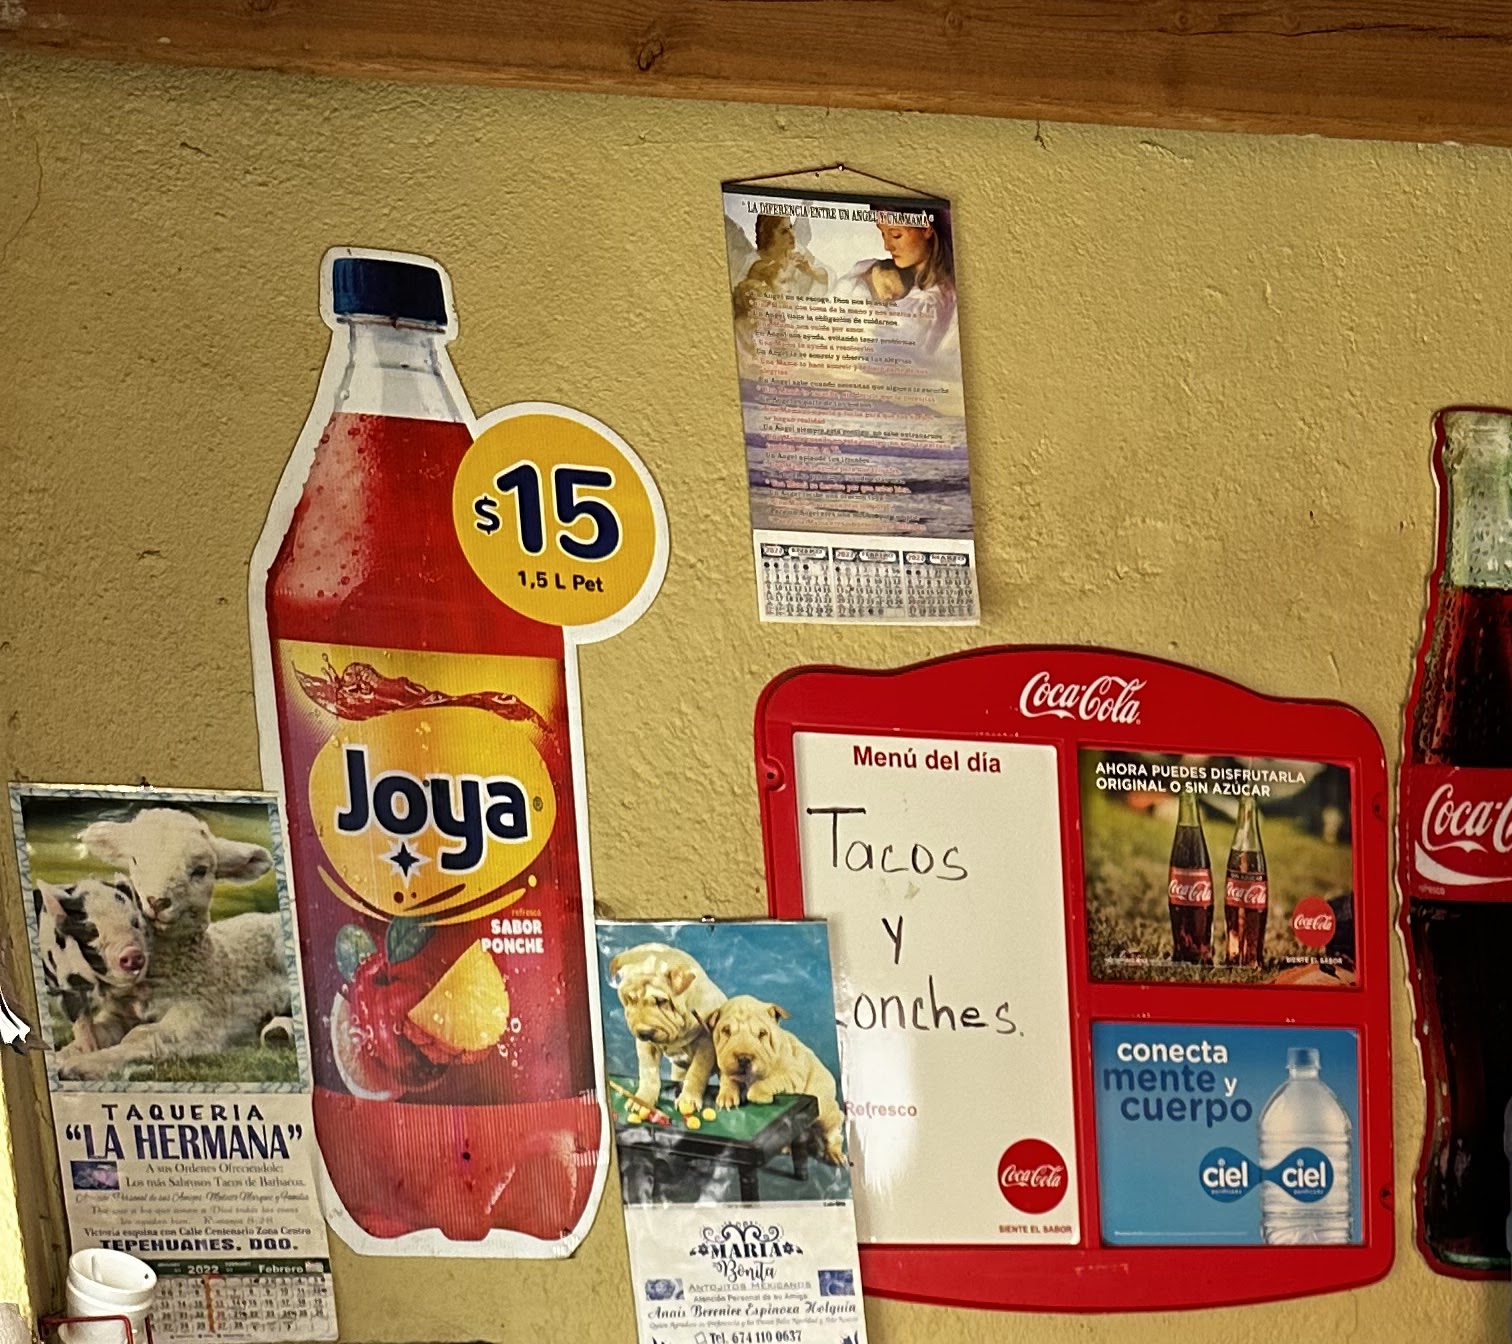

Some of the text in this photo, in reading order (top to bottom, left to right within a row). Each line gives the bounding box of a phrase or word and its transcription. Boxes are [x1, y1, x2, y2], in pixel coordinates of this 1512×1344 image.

[760, 202, 808, 217] DIFERENCIA
[810, 206, 836, 219] ENTRE
[839, 208, 849, 220] UN
[474, 464, 619, 559] $15
[518, 571, 603, 592] 1,5 L Pet
[1019, 671, 1147, 724] Coca-Cola
[853, 745, 1001, 773] Menú del día
[1096, 762, 1305, 784] AHORA PUEDES DISFRUTARLA
[1096, 777, 1270, 797] ORIGINAL O SIN AZÚCAR
[338, 749, 529, 871] Joya
[807, 807, 968, 880] Tacos
[491, 920, 542, 935] SABOR
[1294, 914, 1333, 930] Coca-Cola
[481, 938, 543, 955] PONCHE
[836, 975, 1024, 1037] onches.
[1117, 1040, 1228, 1063] conecta
[1104, 1065, 1237, 1097] mente y
[102, 1104, 263, 1121] TAQUERIA
[1121, 1097, 1252, 1127] cuerpo
[126, 1177, 144, 1187] Los
[214, 1177, 242, 1187] Tacos
[245, 1177, 256, 1186] de
[1002, 1164, 1063, 1187] Coca-Cola
[1203, 1158, 1248, 1187] ciel
[1282, 1159, 1326, 1187] ciel
[179, 1227, 202, 1235] Calle
[205, 1227, 254, 1235] Centenario
[257, 1227, 278, 1235] Zona
[711, 1242, 782, 1258] MARIA
[188, 1264, 303, 1274] 2022 Febrero
[713, 1259, 776, 1282] Bonita
[710, 1330, 802, 1344] Tel. 674 110 0637
